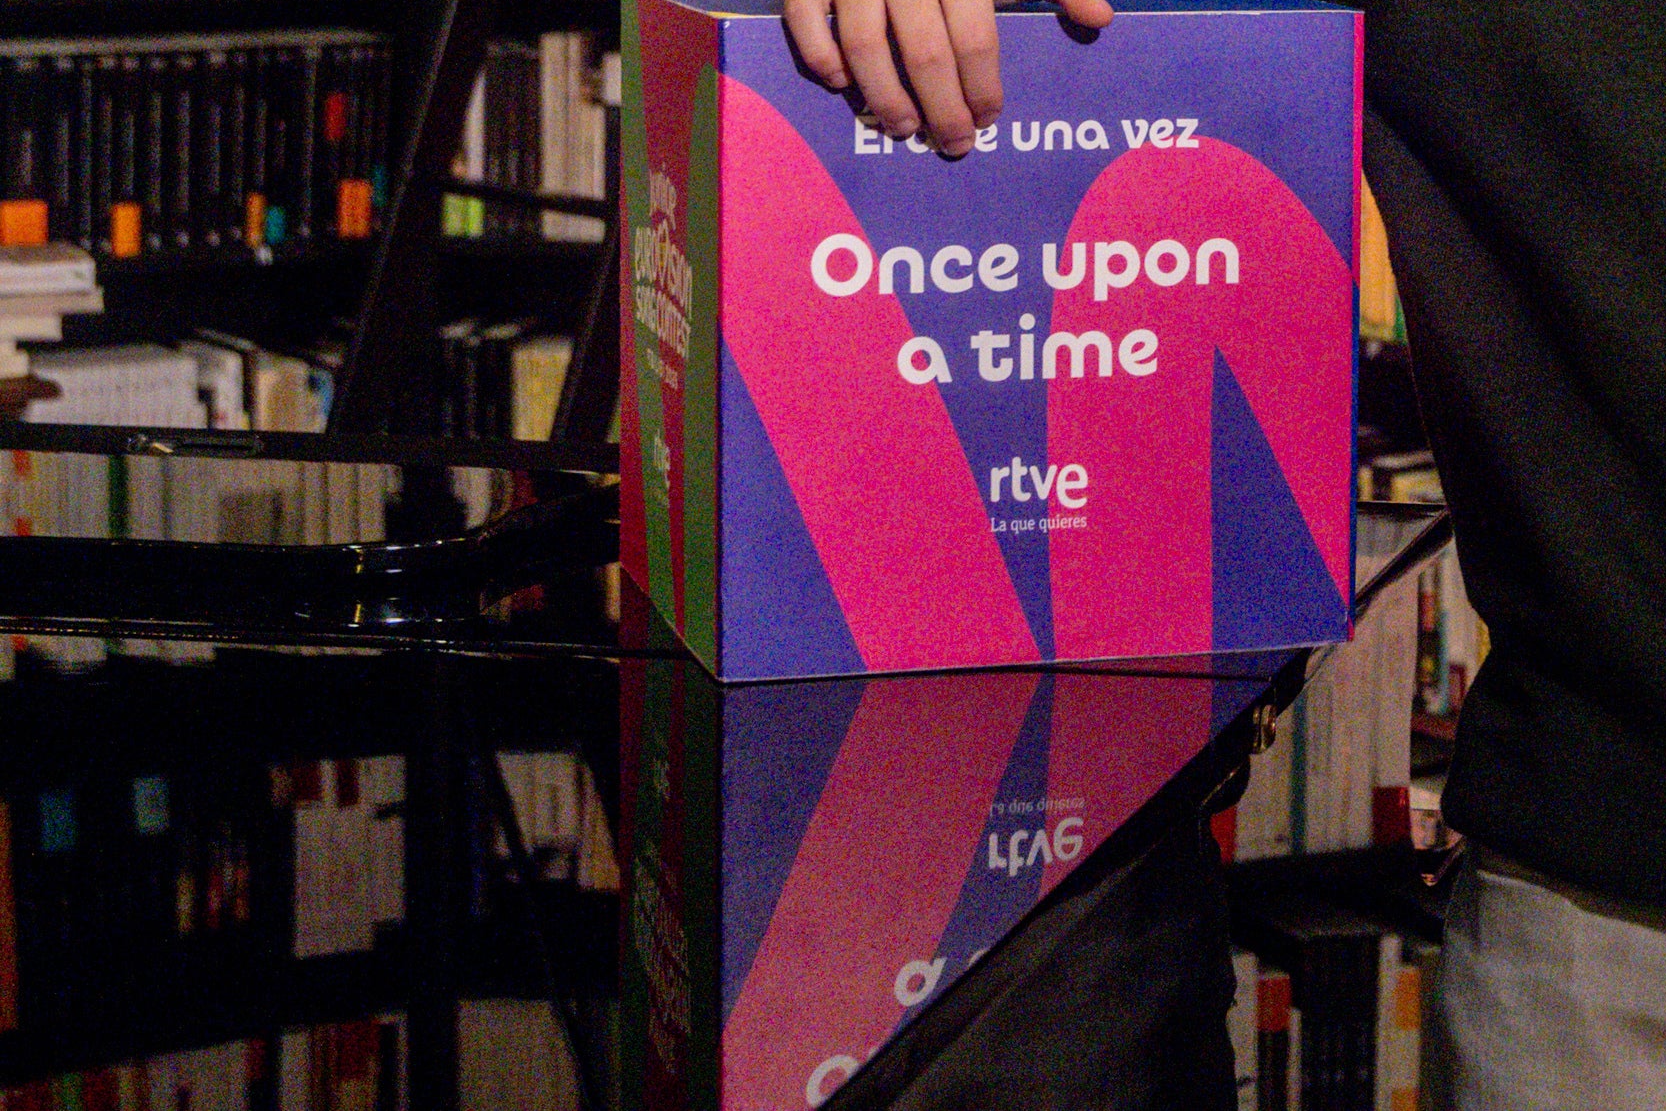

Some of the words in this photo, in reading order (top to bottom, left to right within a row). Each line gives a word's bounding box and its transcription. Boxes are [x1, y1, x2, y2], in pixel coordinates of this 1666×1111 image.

[1011, 119, 1110, 152] una
[1120, 118, 1200, 149] vez
[810, 233, 1020, 297] Once
[1042, 237, 1240, 302] upon
[897, 335, 953, 385] a
[970, 313, 1159, 382] time
[990, 456, 1089, 509] rtve
[990, 517, 1007, 533] La
[1010, 518, 1036, 534] que
[1038, 514, 1088, 533] quieres
